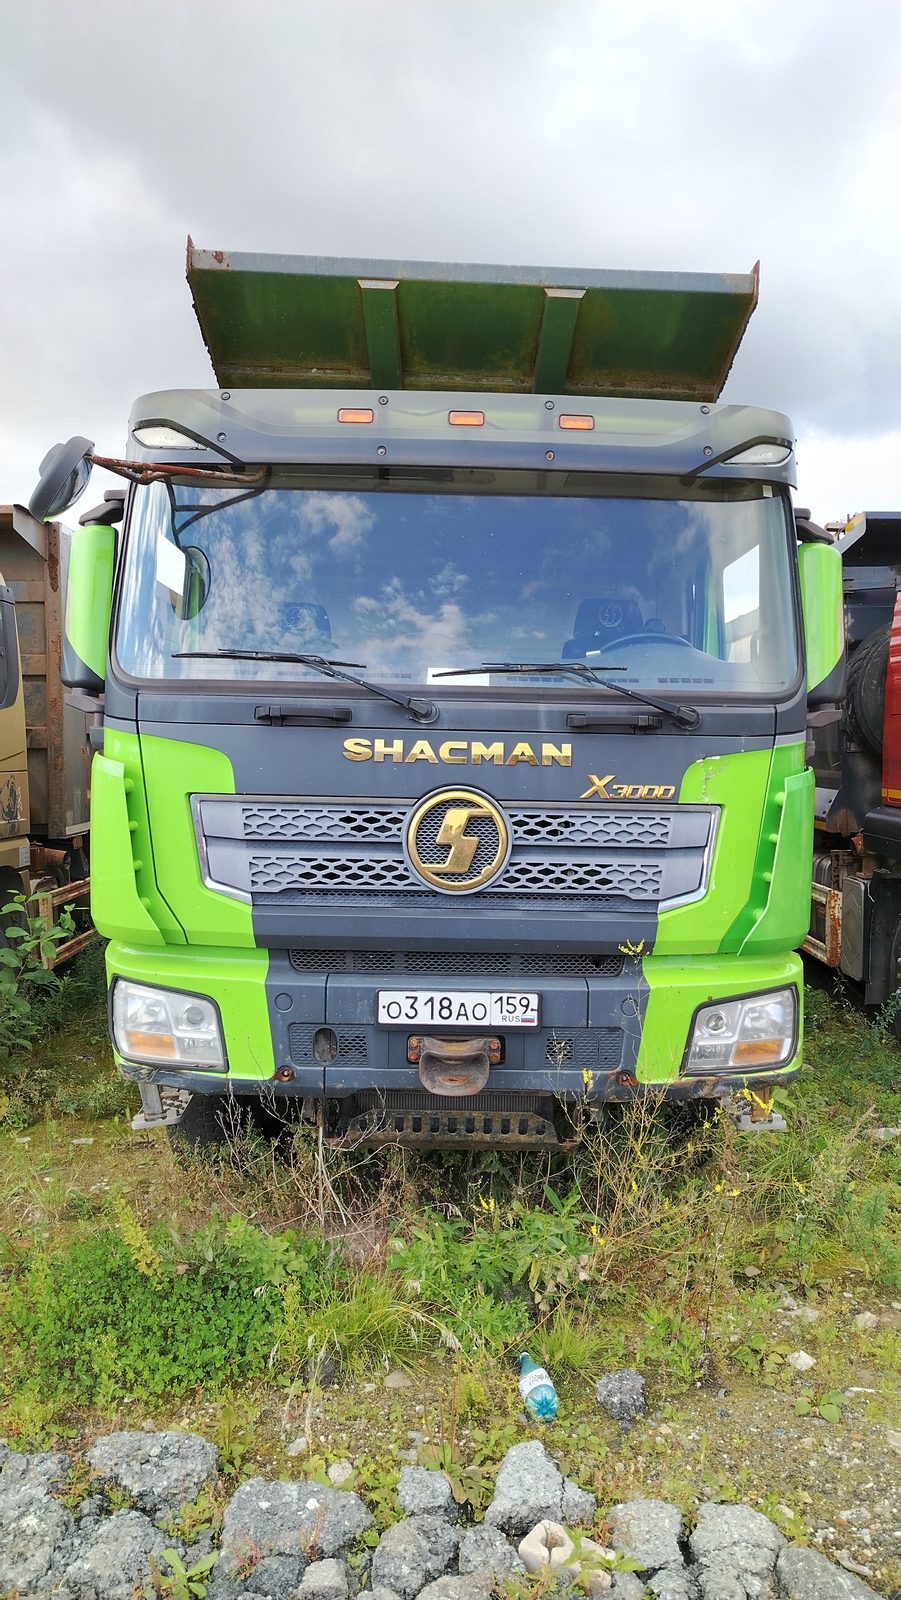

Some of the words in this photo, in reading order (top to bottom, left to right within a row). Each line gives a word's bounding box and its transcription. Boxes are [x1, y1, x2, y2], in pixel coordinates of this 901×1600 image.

[342, 738, 572, 766] SHACMAN
[580, 774, 676, 799] X3000
[494, 996, 530, 1014] 159
